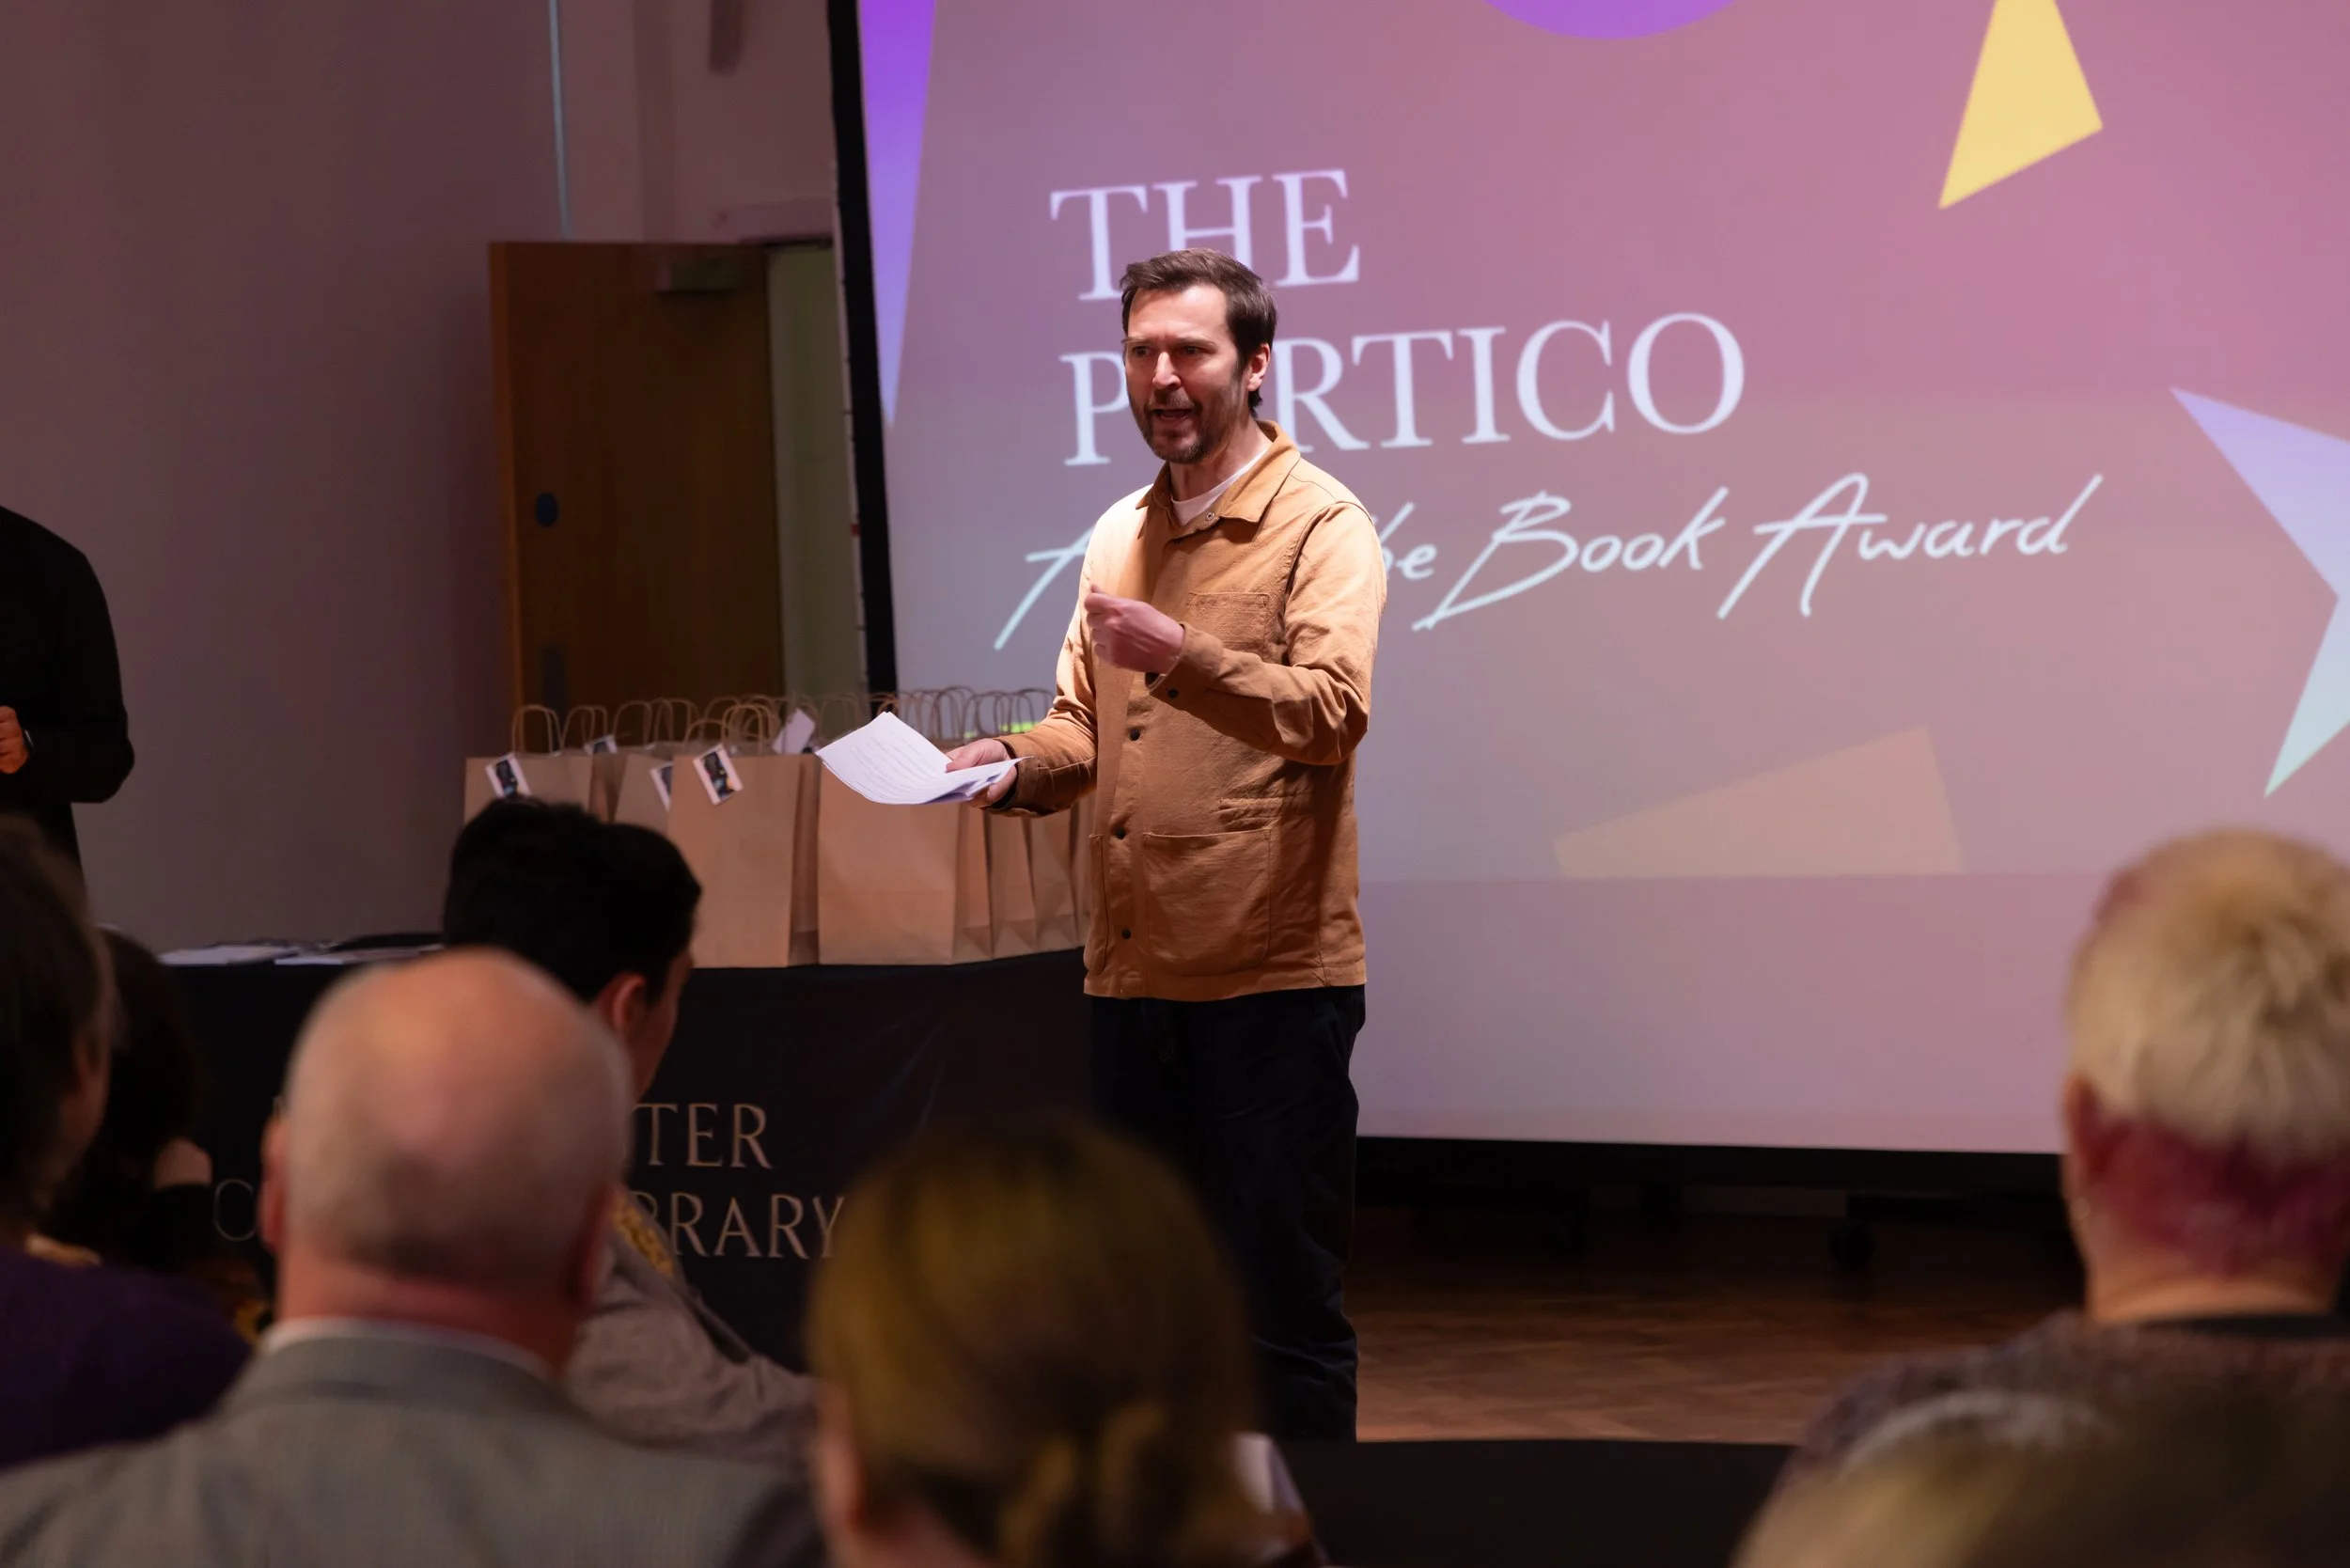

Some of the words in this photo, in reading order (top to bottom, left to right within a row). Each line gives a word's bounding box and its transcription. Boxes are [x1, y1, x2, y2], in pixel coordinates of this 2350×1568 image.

[1049, 168, 1361, 302] THE
[1058, 312, 1745, 466] PRTICO
[1411, 489, 1728, 632] Book
[1717, 472, 2104, 619] Award
[630, 1189, 846, 1261] RARY
